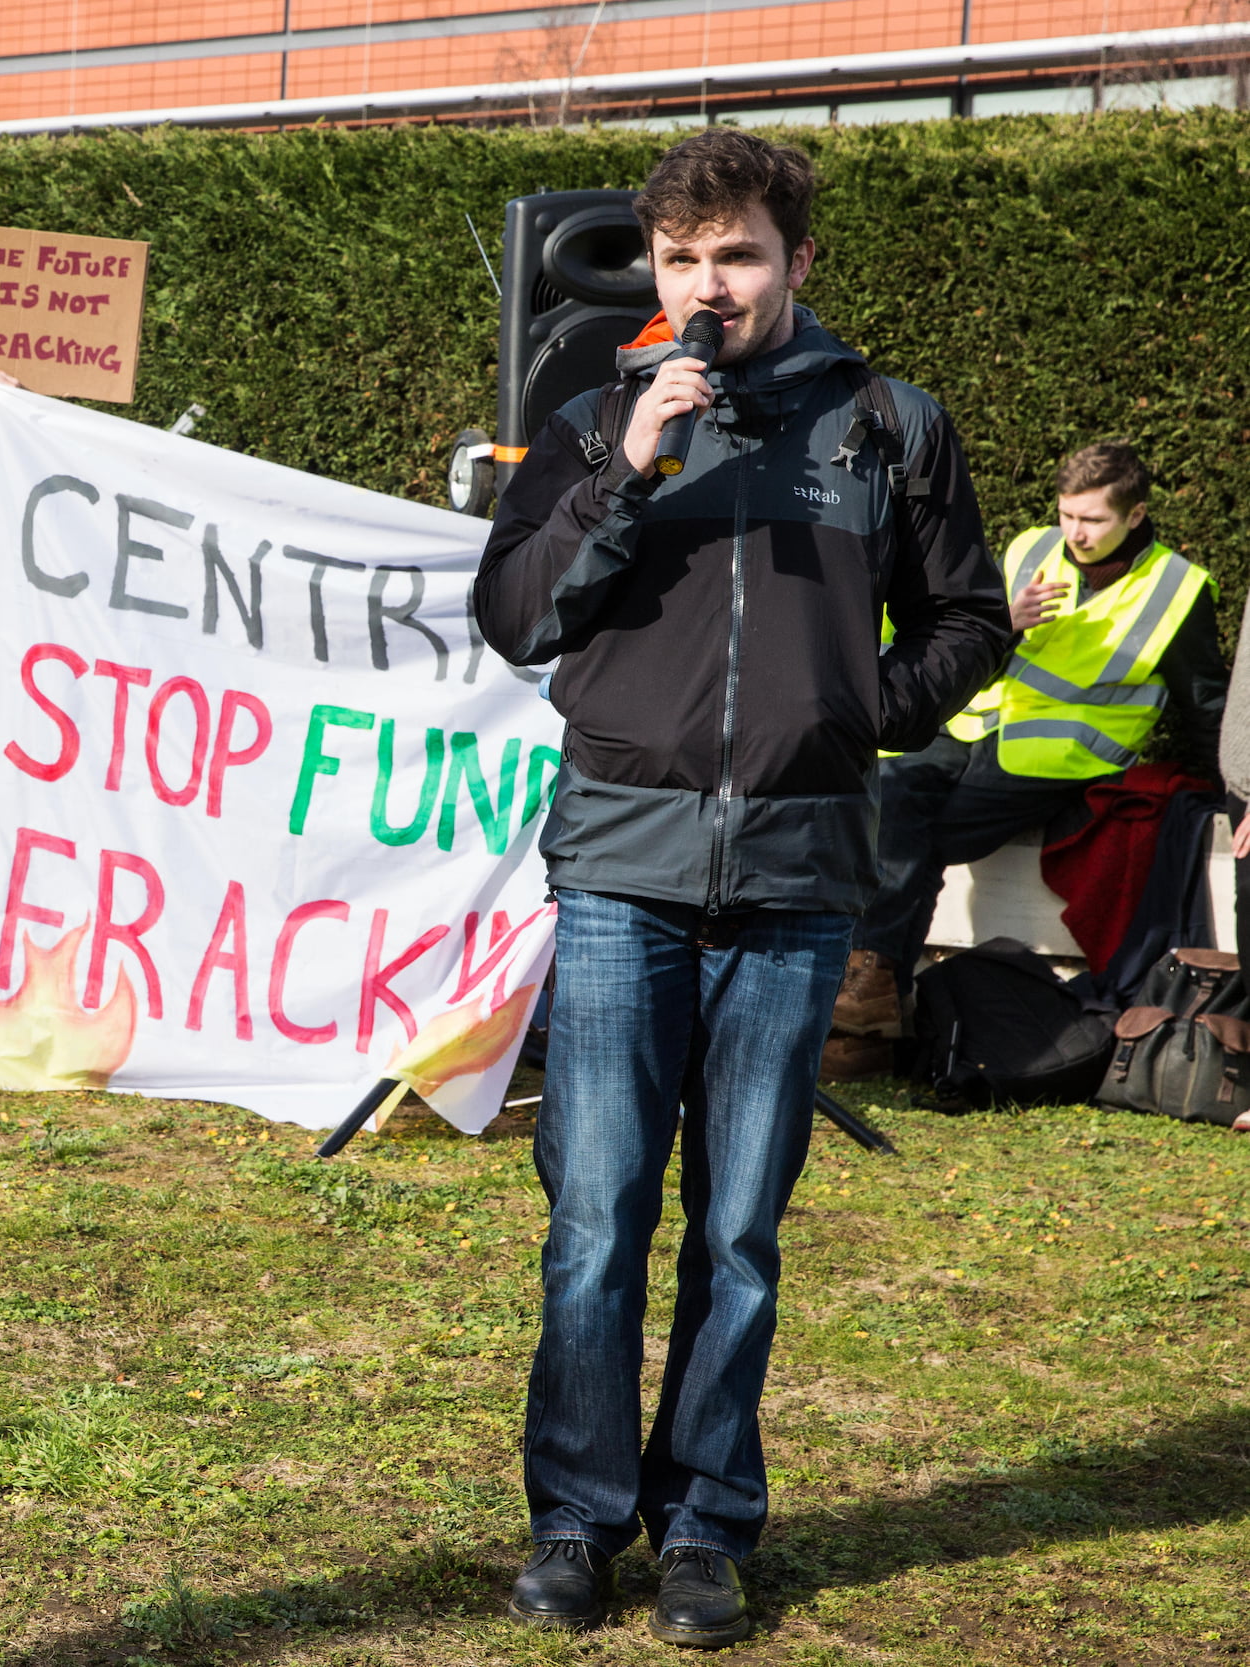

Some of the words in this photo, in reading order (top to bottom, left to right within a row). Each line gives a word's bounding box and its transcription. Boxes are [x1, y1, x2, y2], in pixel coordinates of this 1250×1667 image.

[37, 246, 132, 278] FUTURE
[48, 290, 111, 316] NOT
[809, 486, 841, 505] Rab
[4, 643, 273, 819] STOP
